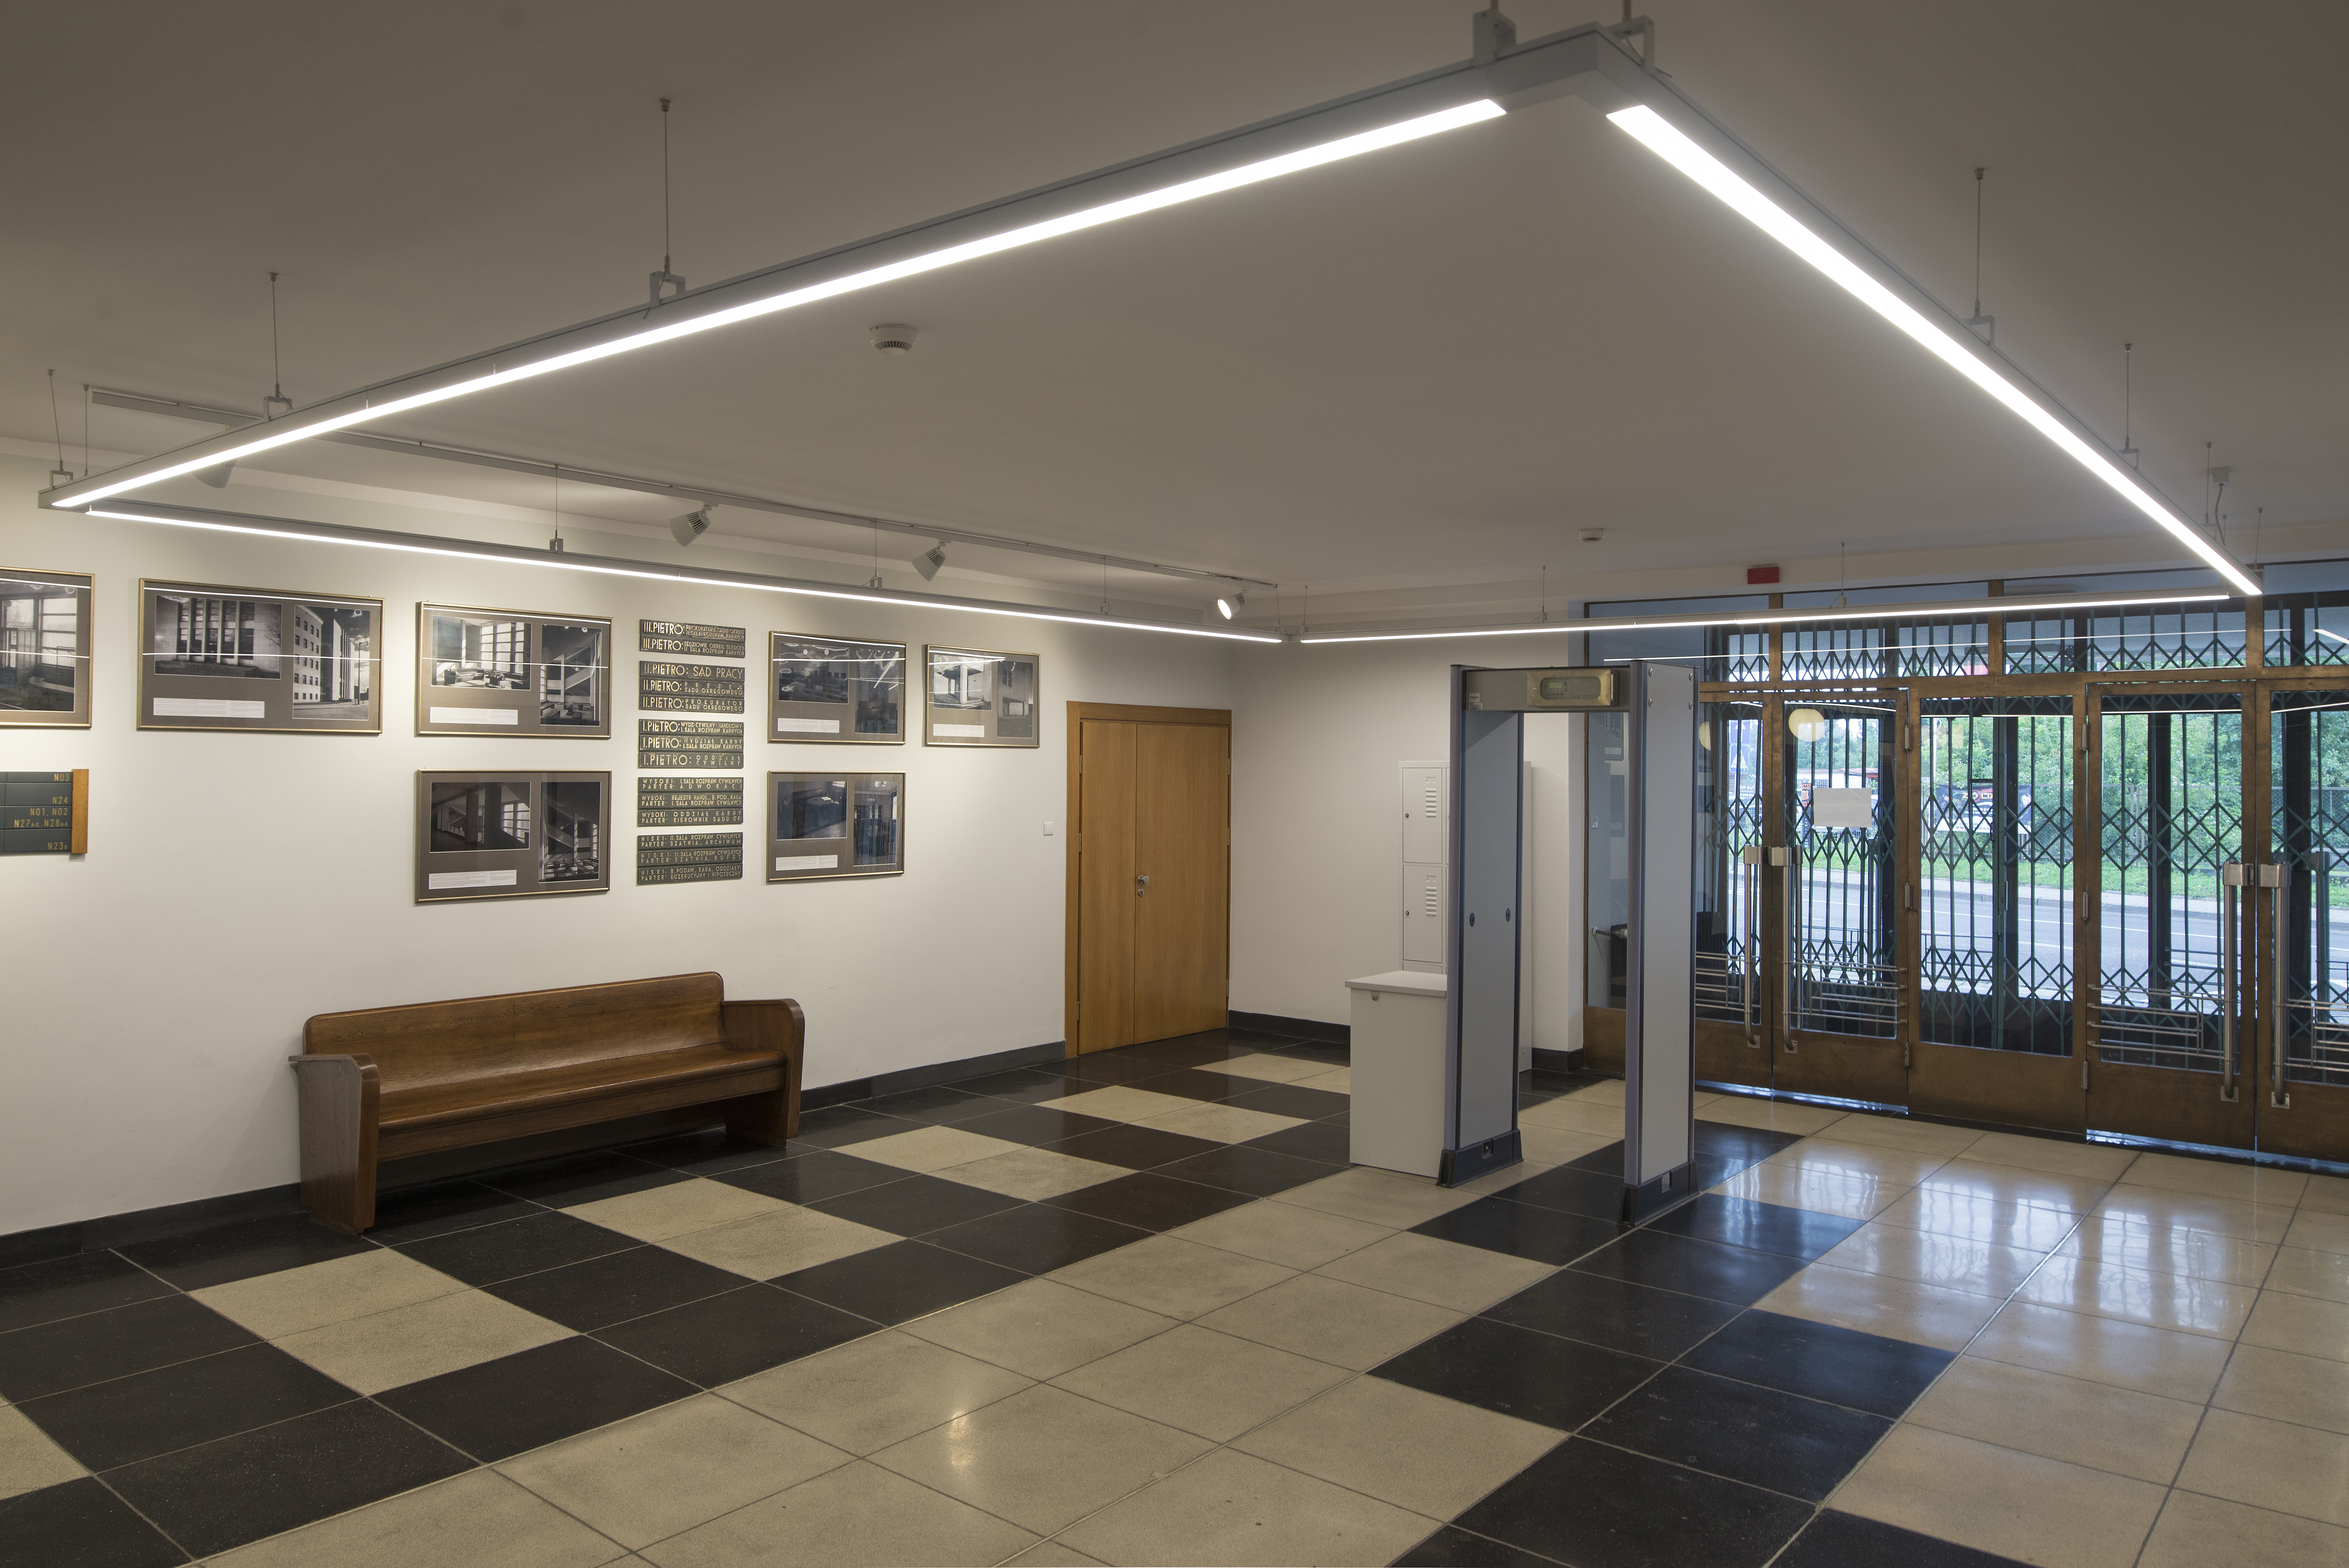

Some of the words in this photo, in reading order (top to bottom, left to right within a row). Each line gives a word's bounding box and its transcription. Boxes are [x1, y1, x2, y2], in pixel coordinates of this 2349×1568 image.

[716, 668, 743, 679] PRACY
[52, 796, 68, 804] N24
[52, 807, 68, 816] N02
